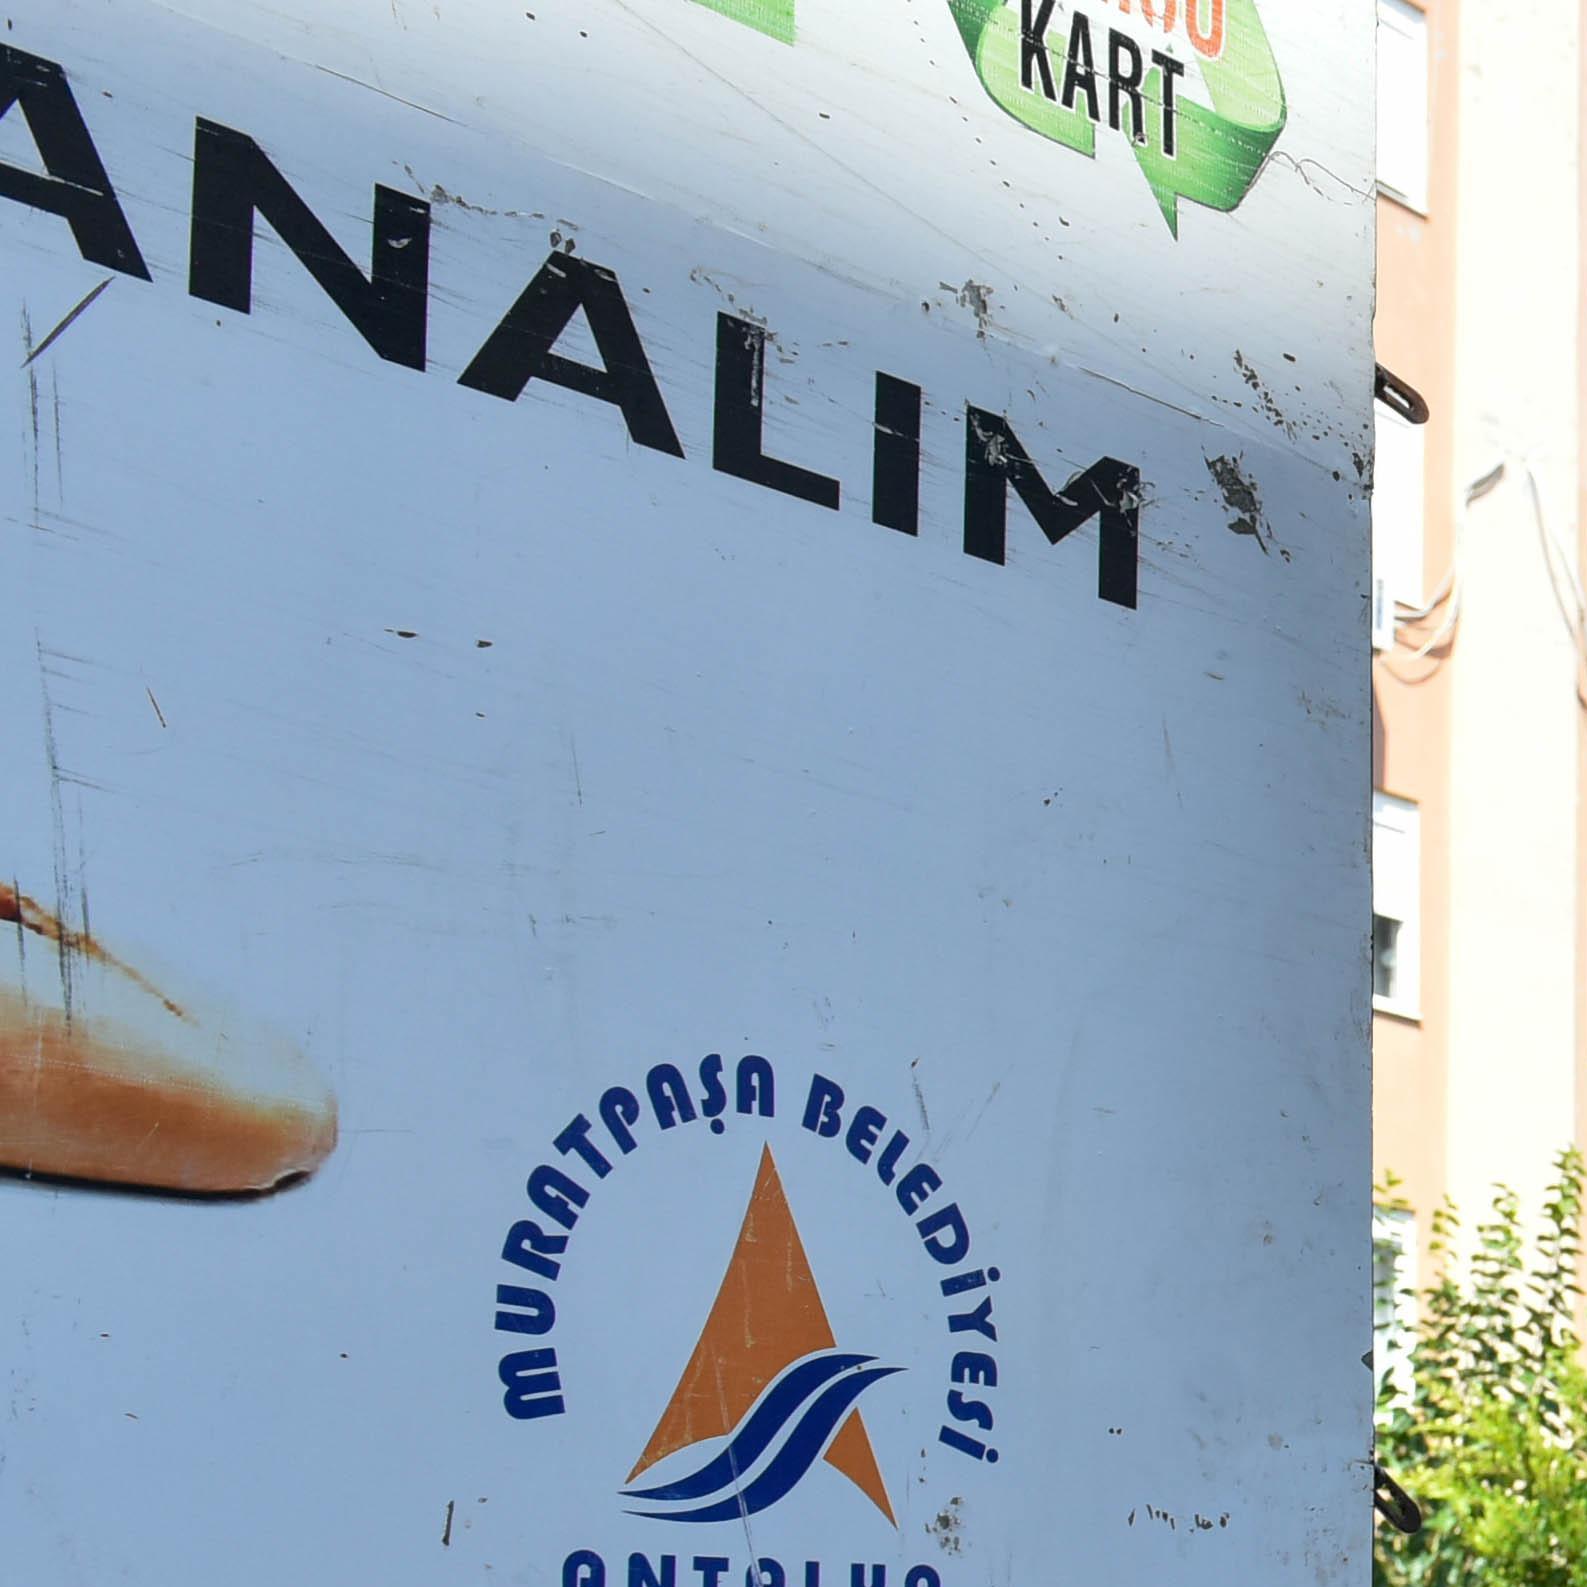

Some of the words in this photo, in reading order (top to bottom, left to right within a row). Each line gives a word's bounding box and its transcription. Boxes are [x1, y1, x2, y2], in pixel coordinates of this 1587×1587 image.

[1020, 0, 1185, 157] KART
[494, 1053, 775, 1420] MURATPAŞA
[801, 1073, 1000, 1465] BELEDİYESİ
